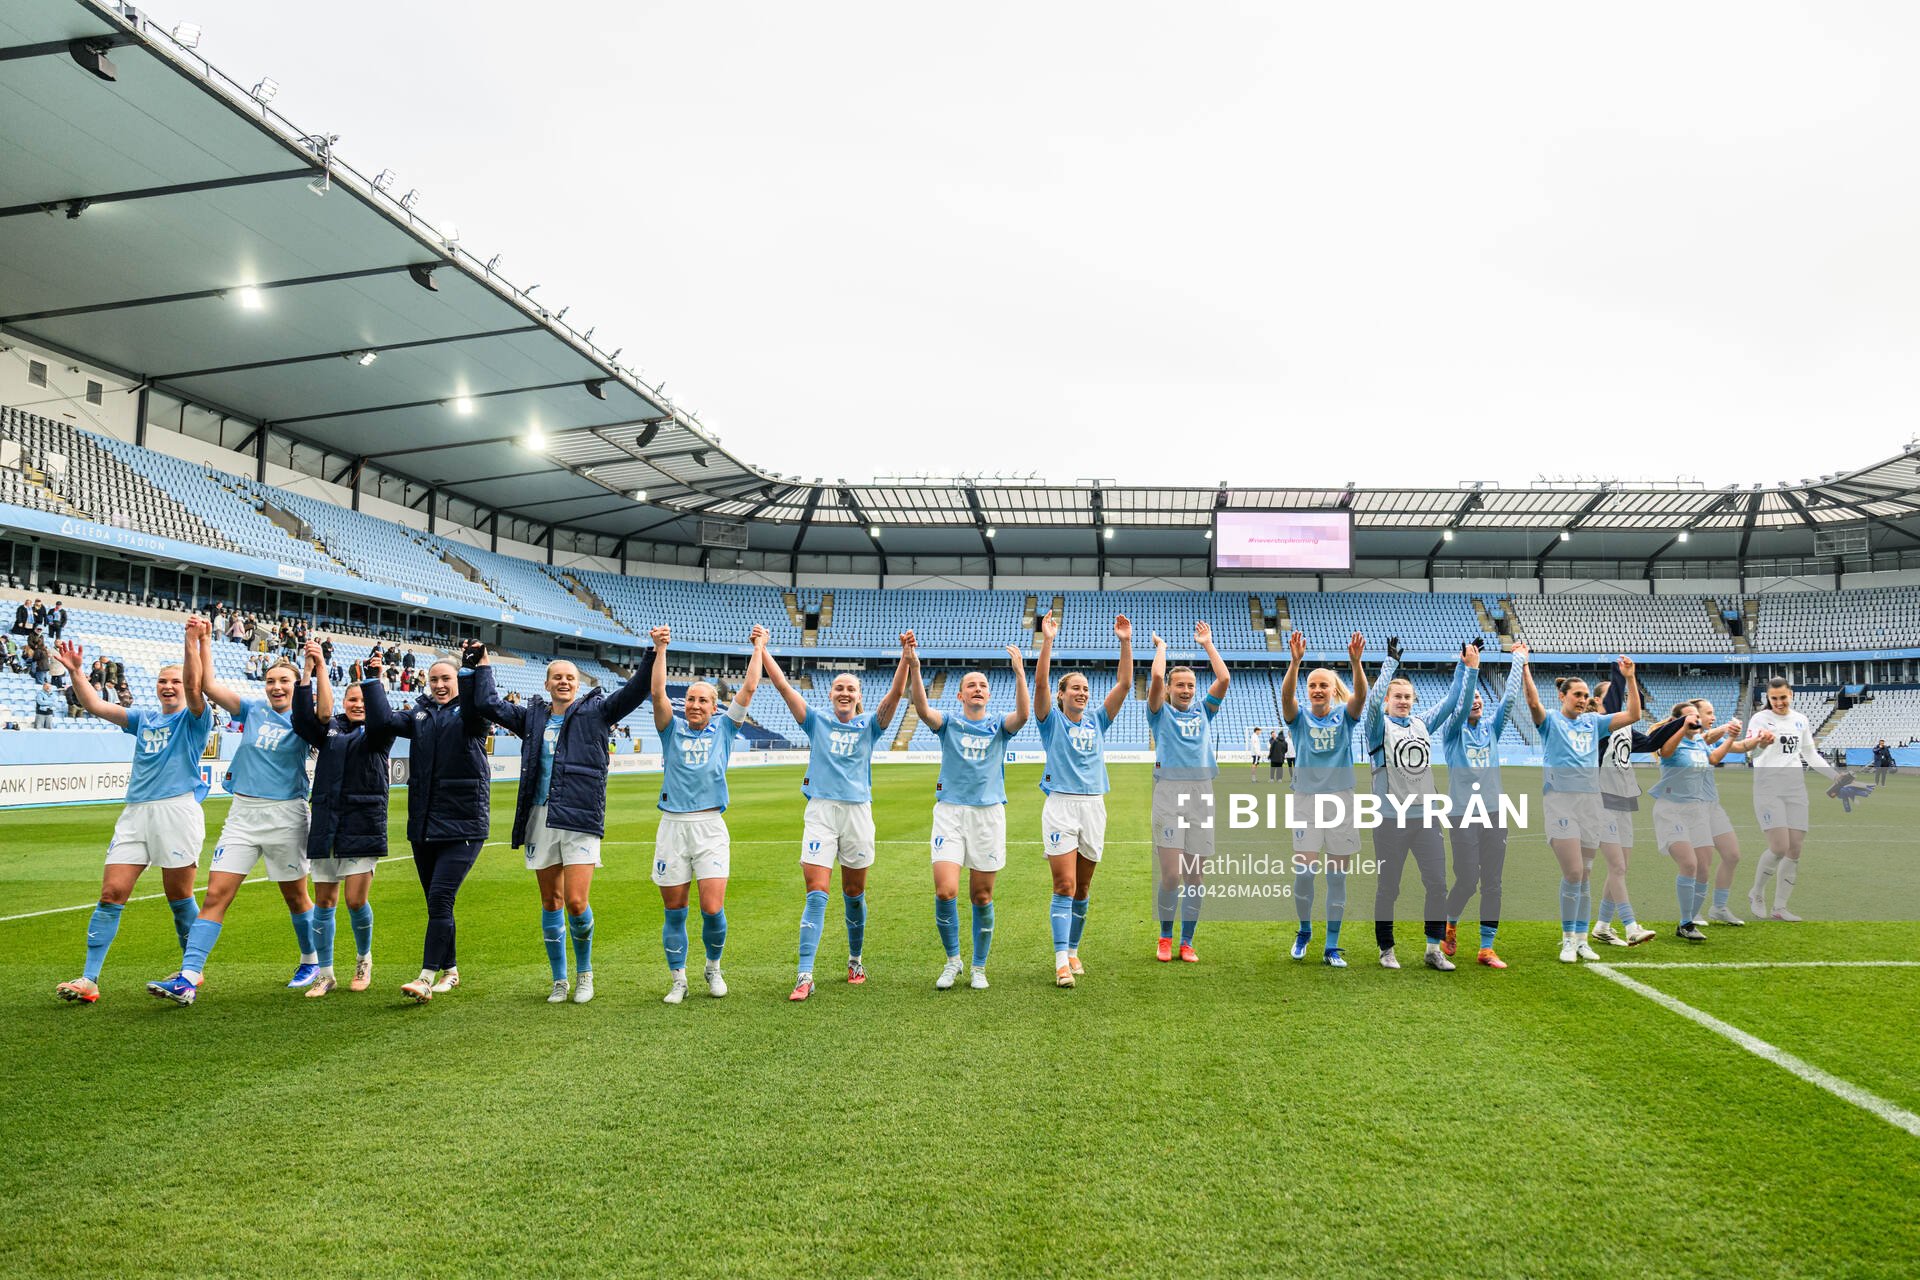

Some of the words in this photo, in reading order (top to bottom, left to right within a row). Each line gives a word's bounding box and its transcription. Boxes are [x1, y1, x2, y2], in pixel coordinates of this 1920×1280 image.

[75, 524, 111, 540] ELEDA
[118, 533, 165, 551] STADION
[1168, 651, 1196, 659] visolve
[0, 778, 26, 793] ANK
[37, 776, 87, 791] PENSION
